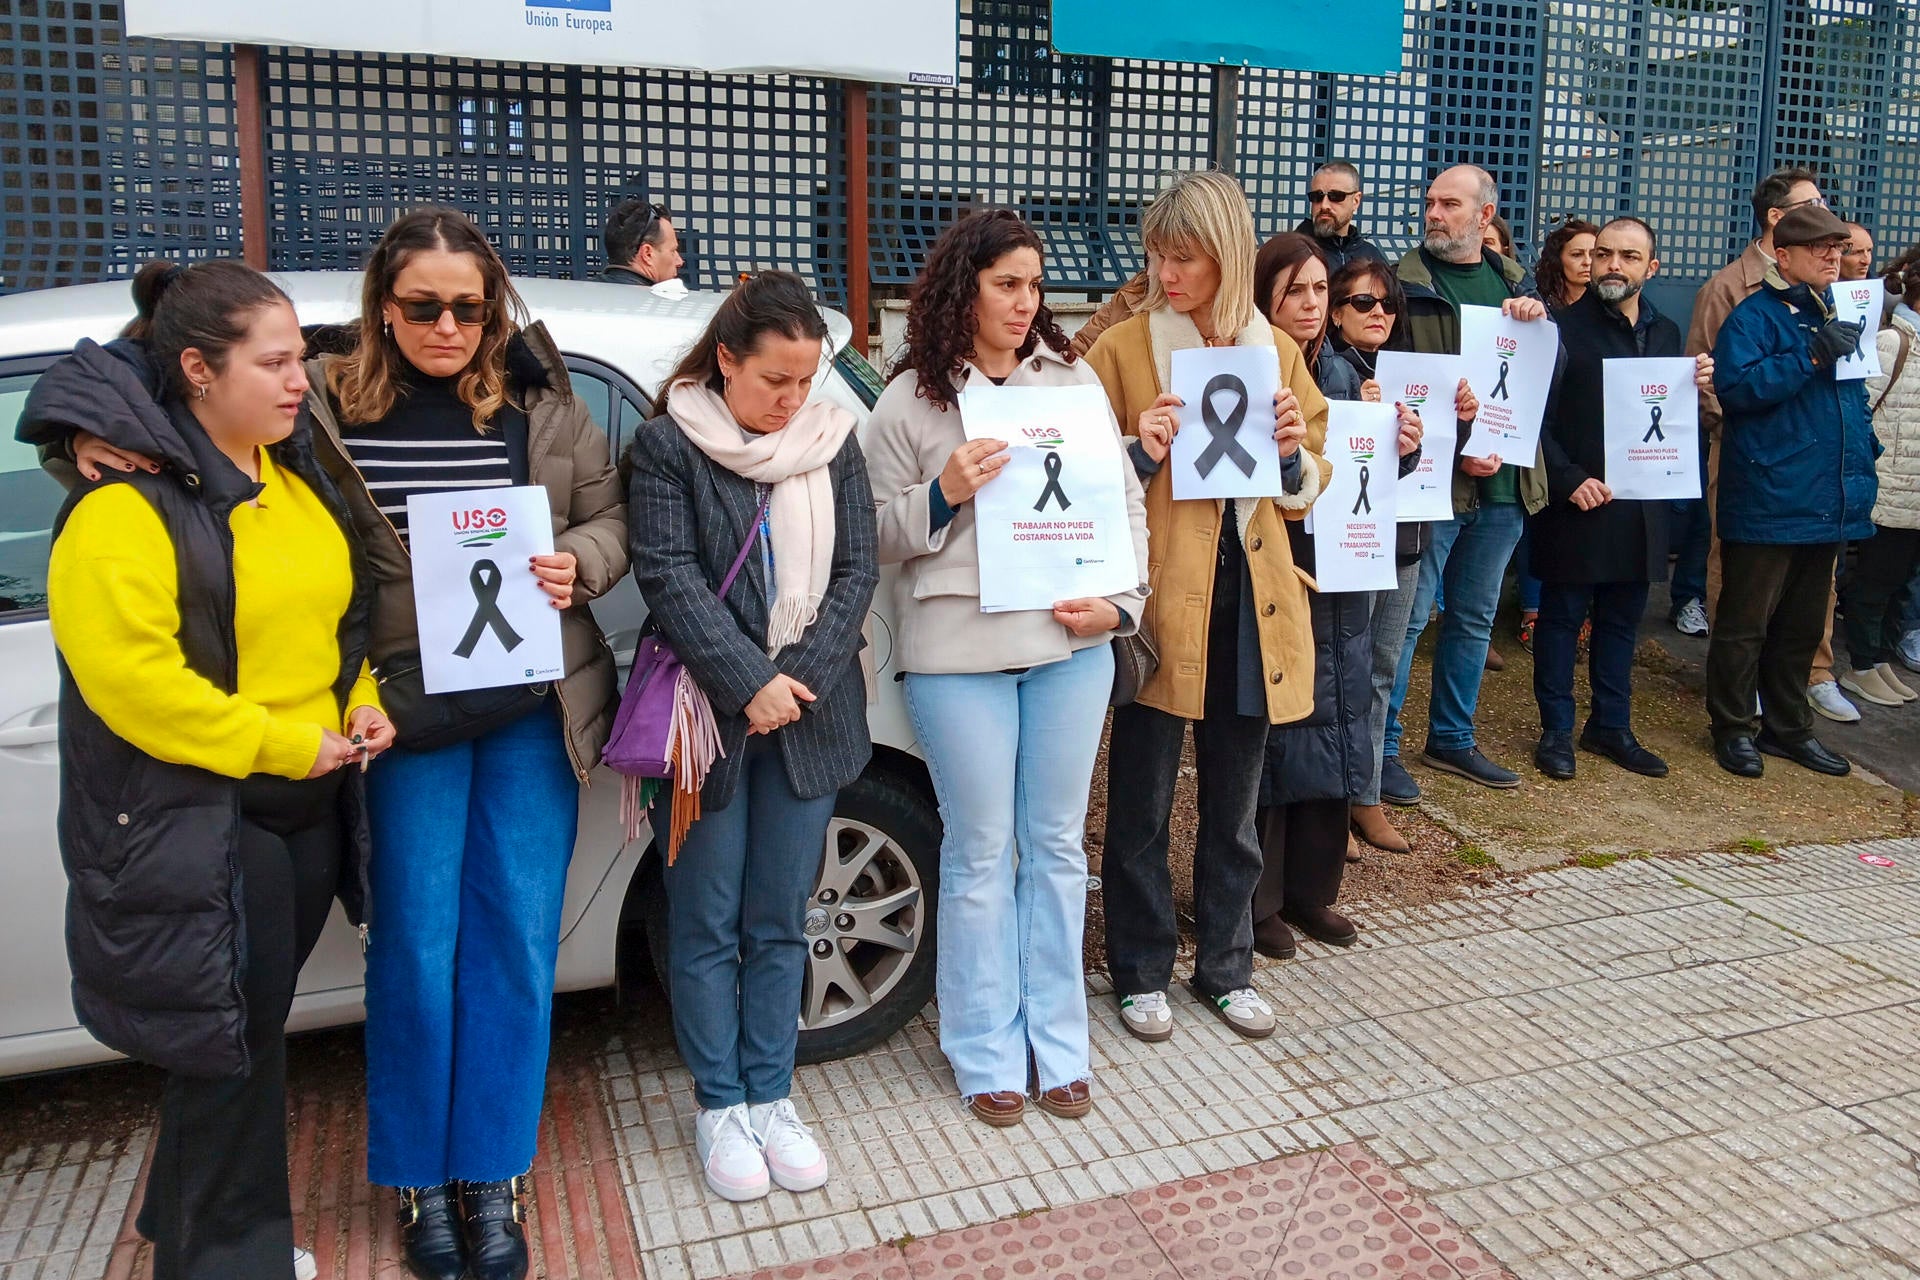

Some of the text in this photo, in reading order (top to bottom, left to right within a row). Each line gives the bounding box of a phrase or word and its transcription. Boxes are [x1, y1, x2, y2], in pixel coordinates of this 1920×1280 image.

[525, 10, 613, 35] Unión Europea
[1851, 289, 1870, 299] USO
[1496, 335, 1517, 351] USO
[1405, 384, 1429, 396] USO
[1641, 384, 1668, 395] USO
[1022, 427, 1062, 437] USO
[1349, 437, 1375, 451] USO
[452, 508, 507, 530] USO
[1012, 522, 1052, 530] TRABAJAR
[1067, 521, 1095, 529] PUEDE
[1013, 532, 1095, 541] COSTARNOS LA VIDA
